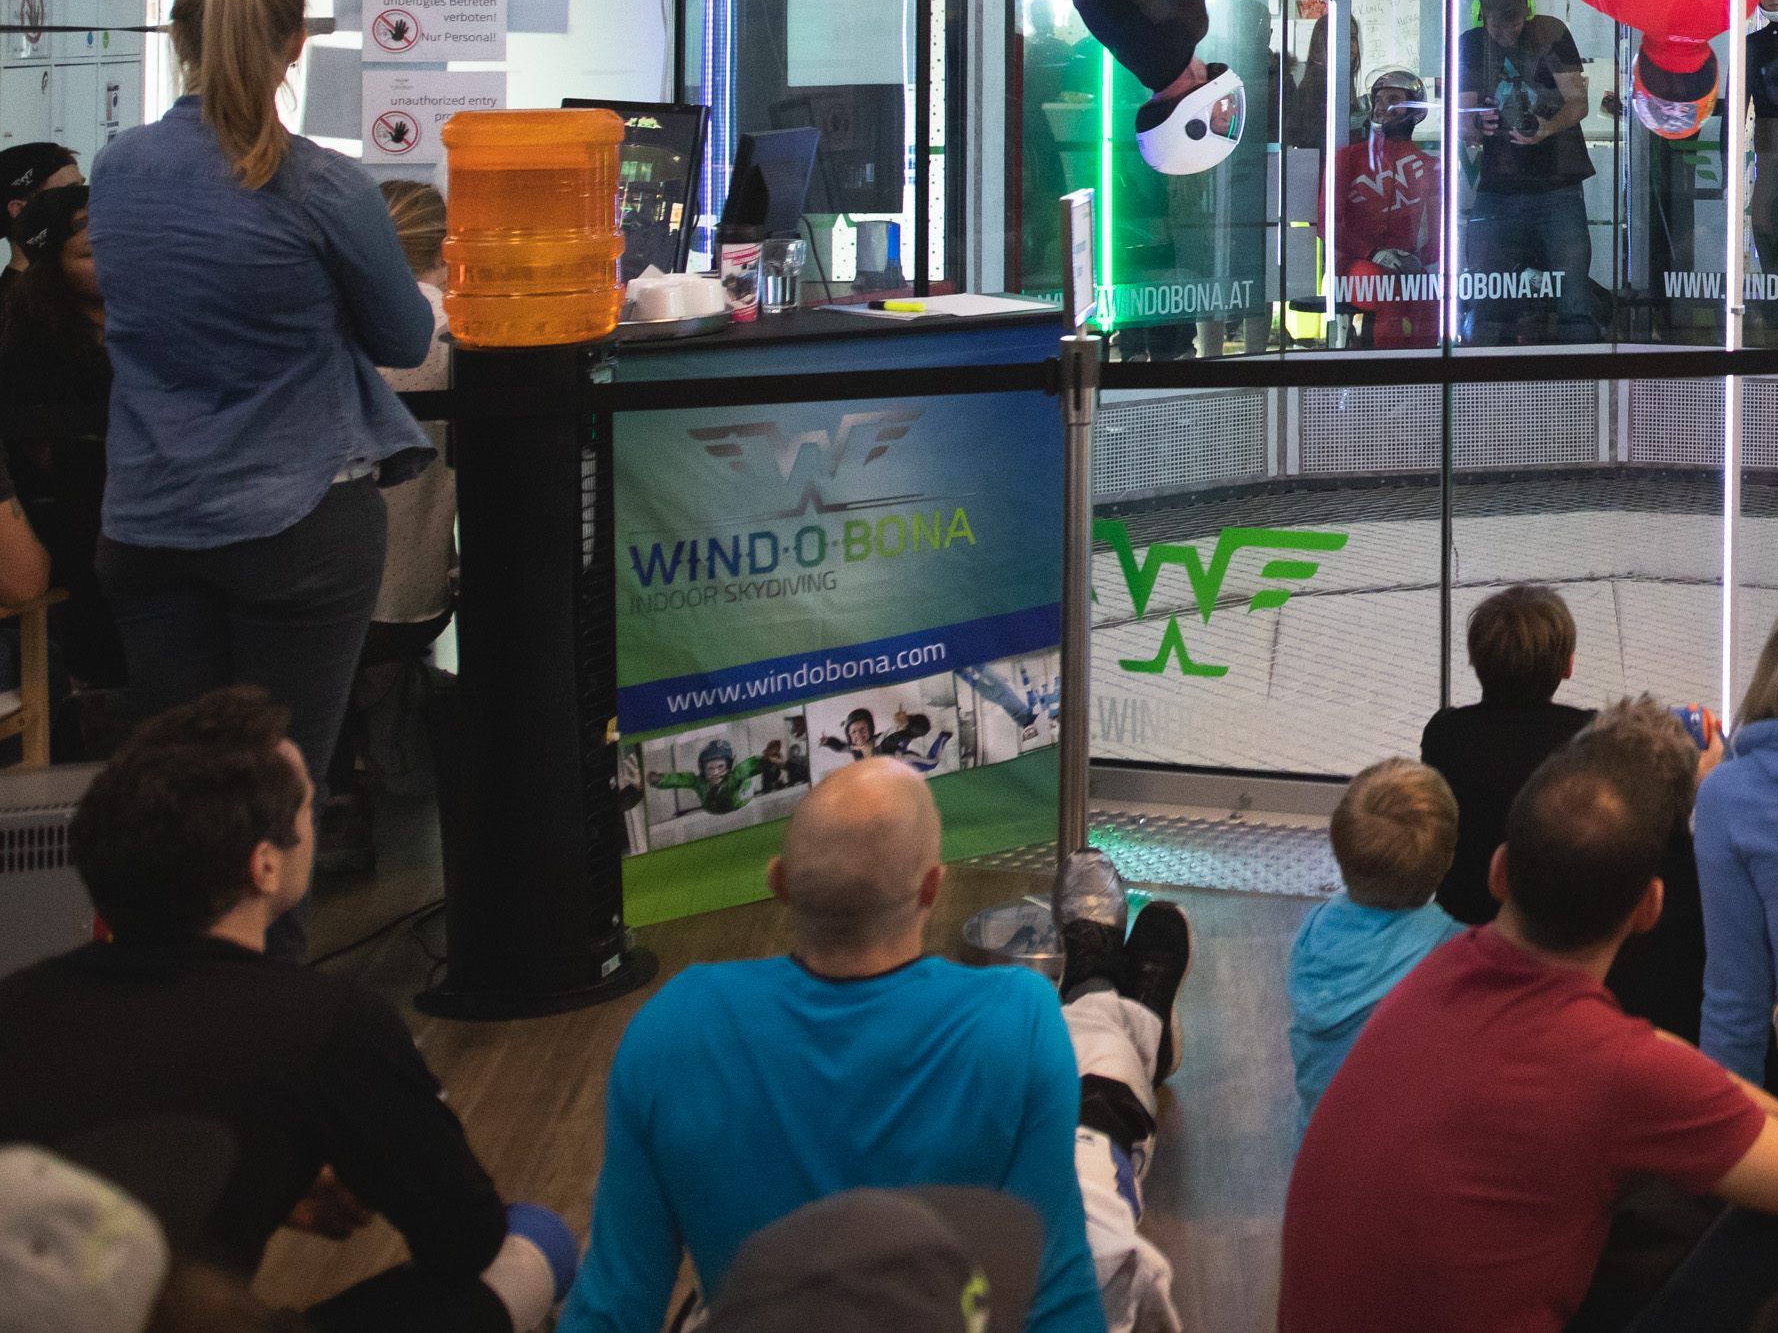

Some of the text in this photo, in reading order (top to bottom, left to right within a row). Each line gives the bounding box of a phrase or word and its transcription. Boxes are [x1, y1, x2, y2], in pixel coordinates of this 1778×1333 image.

[443, 12, 497, 22] verboten!
[421, 32, 497, 42] Nur Personal!
[390, 96, 498, 108] unauthorized entry
[1335, 270, 1566, 303] WWW.WINOBONA.AT
[629, 570, 838, 616] INDOOR SKYDIVING
[667, 639, 946, 714] www.windobona.com
